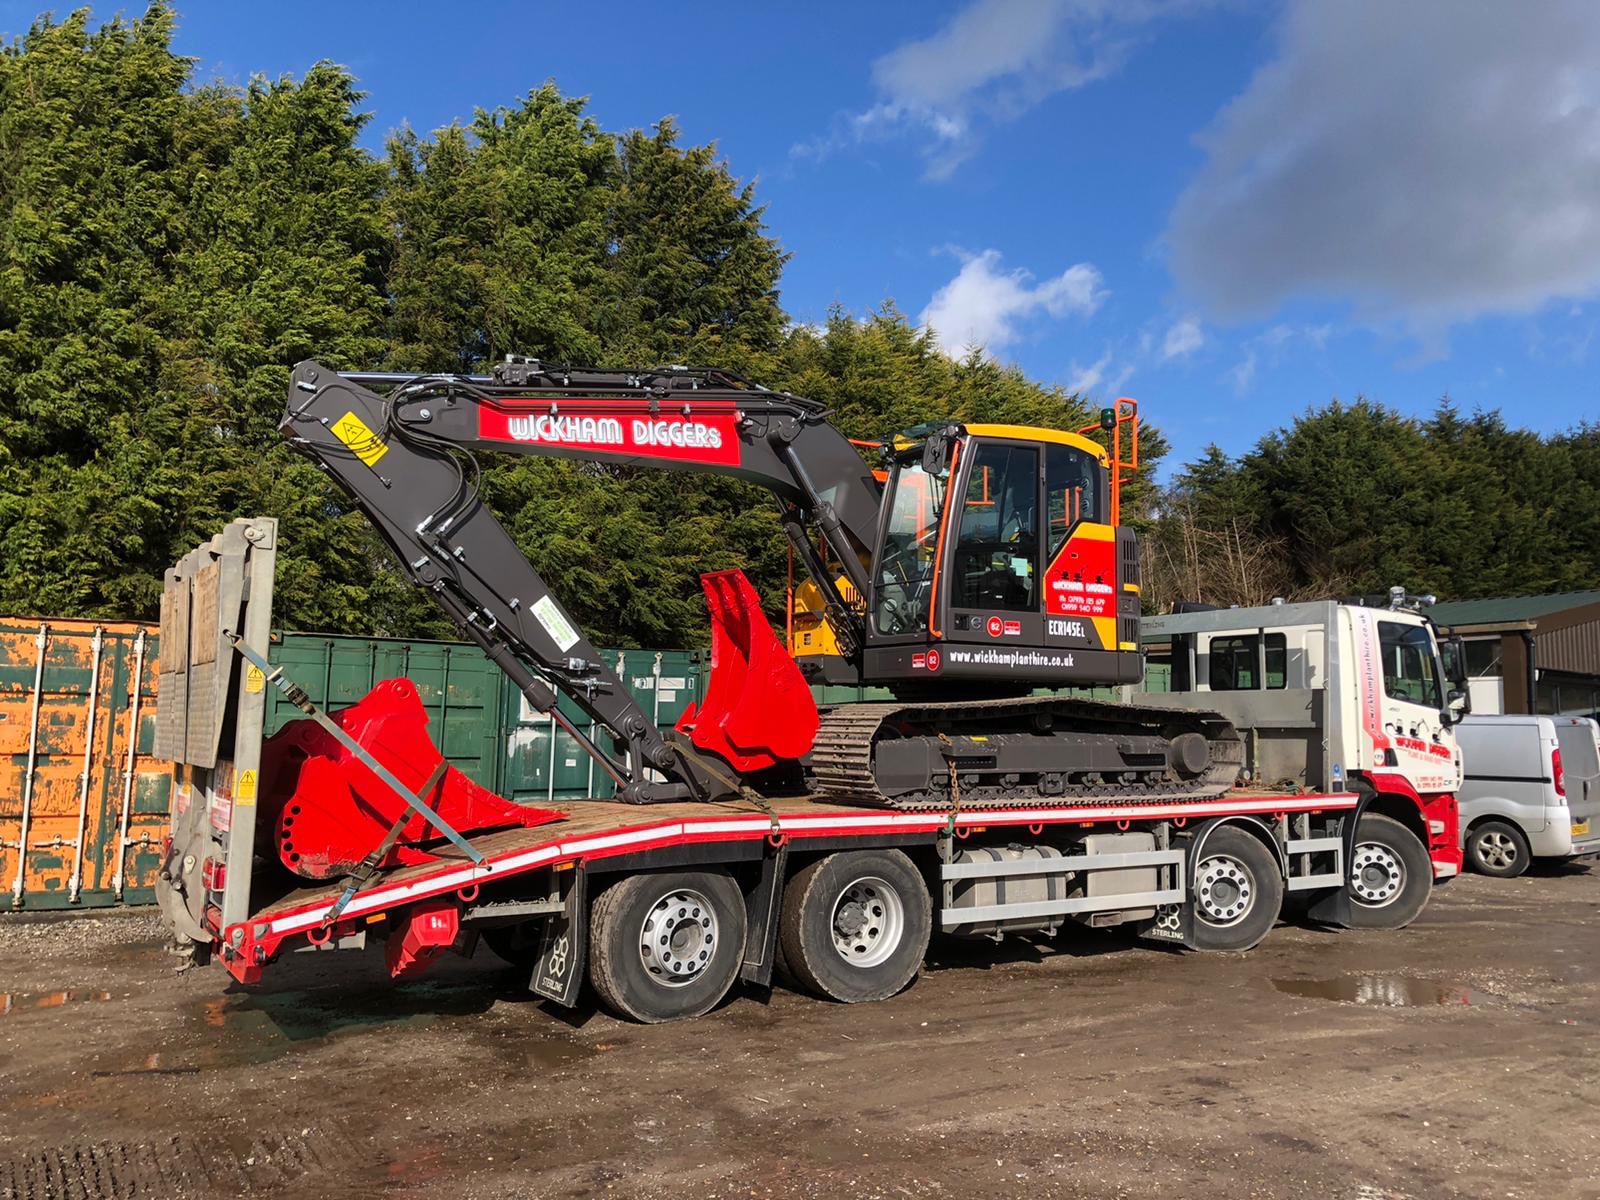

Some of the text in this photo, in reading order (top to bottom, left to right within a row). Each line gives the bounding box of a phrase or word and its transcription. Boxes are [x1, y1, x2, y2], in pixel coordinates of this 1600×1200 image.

[632, 420, 721, 448] DIGGERS
[950, 650, 1074, 668] www.wickhamplanthire.co.uk
[1151, 928, 1184, 940] STERLING
